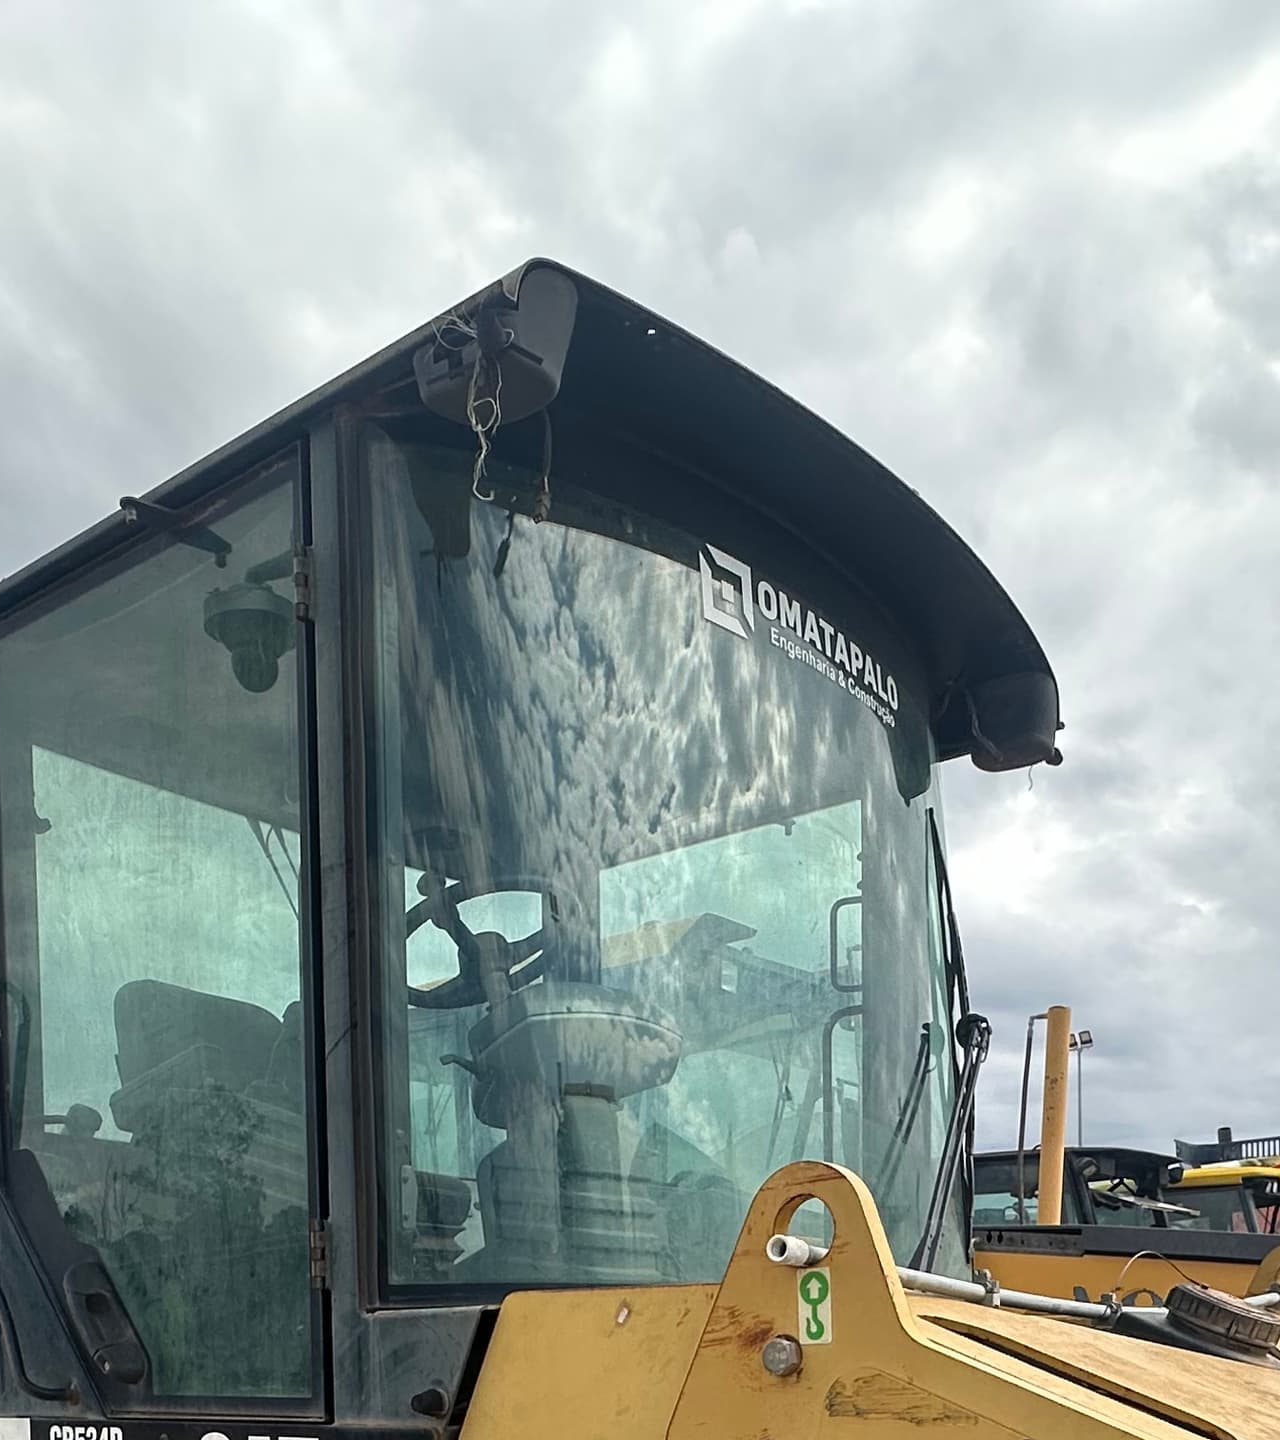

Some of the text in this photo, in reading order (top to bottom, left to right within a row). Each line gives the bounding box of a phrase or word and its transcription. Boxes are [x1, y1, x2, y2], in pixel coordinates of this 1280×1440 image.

[757, 580, 899, 711] OMATAPALO
[770, 626, 896, 728] Engenharia & Construção
